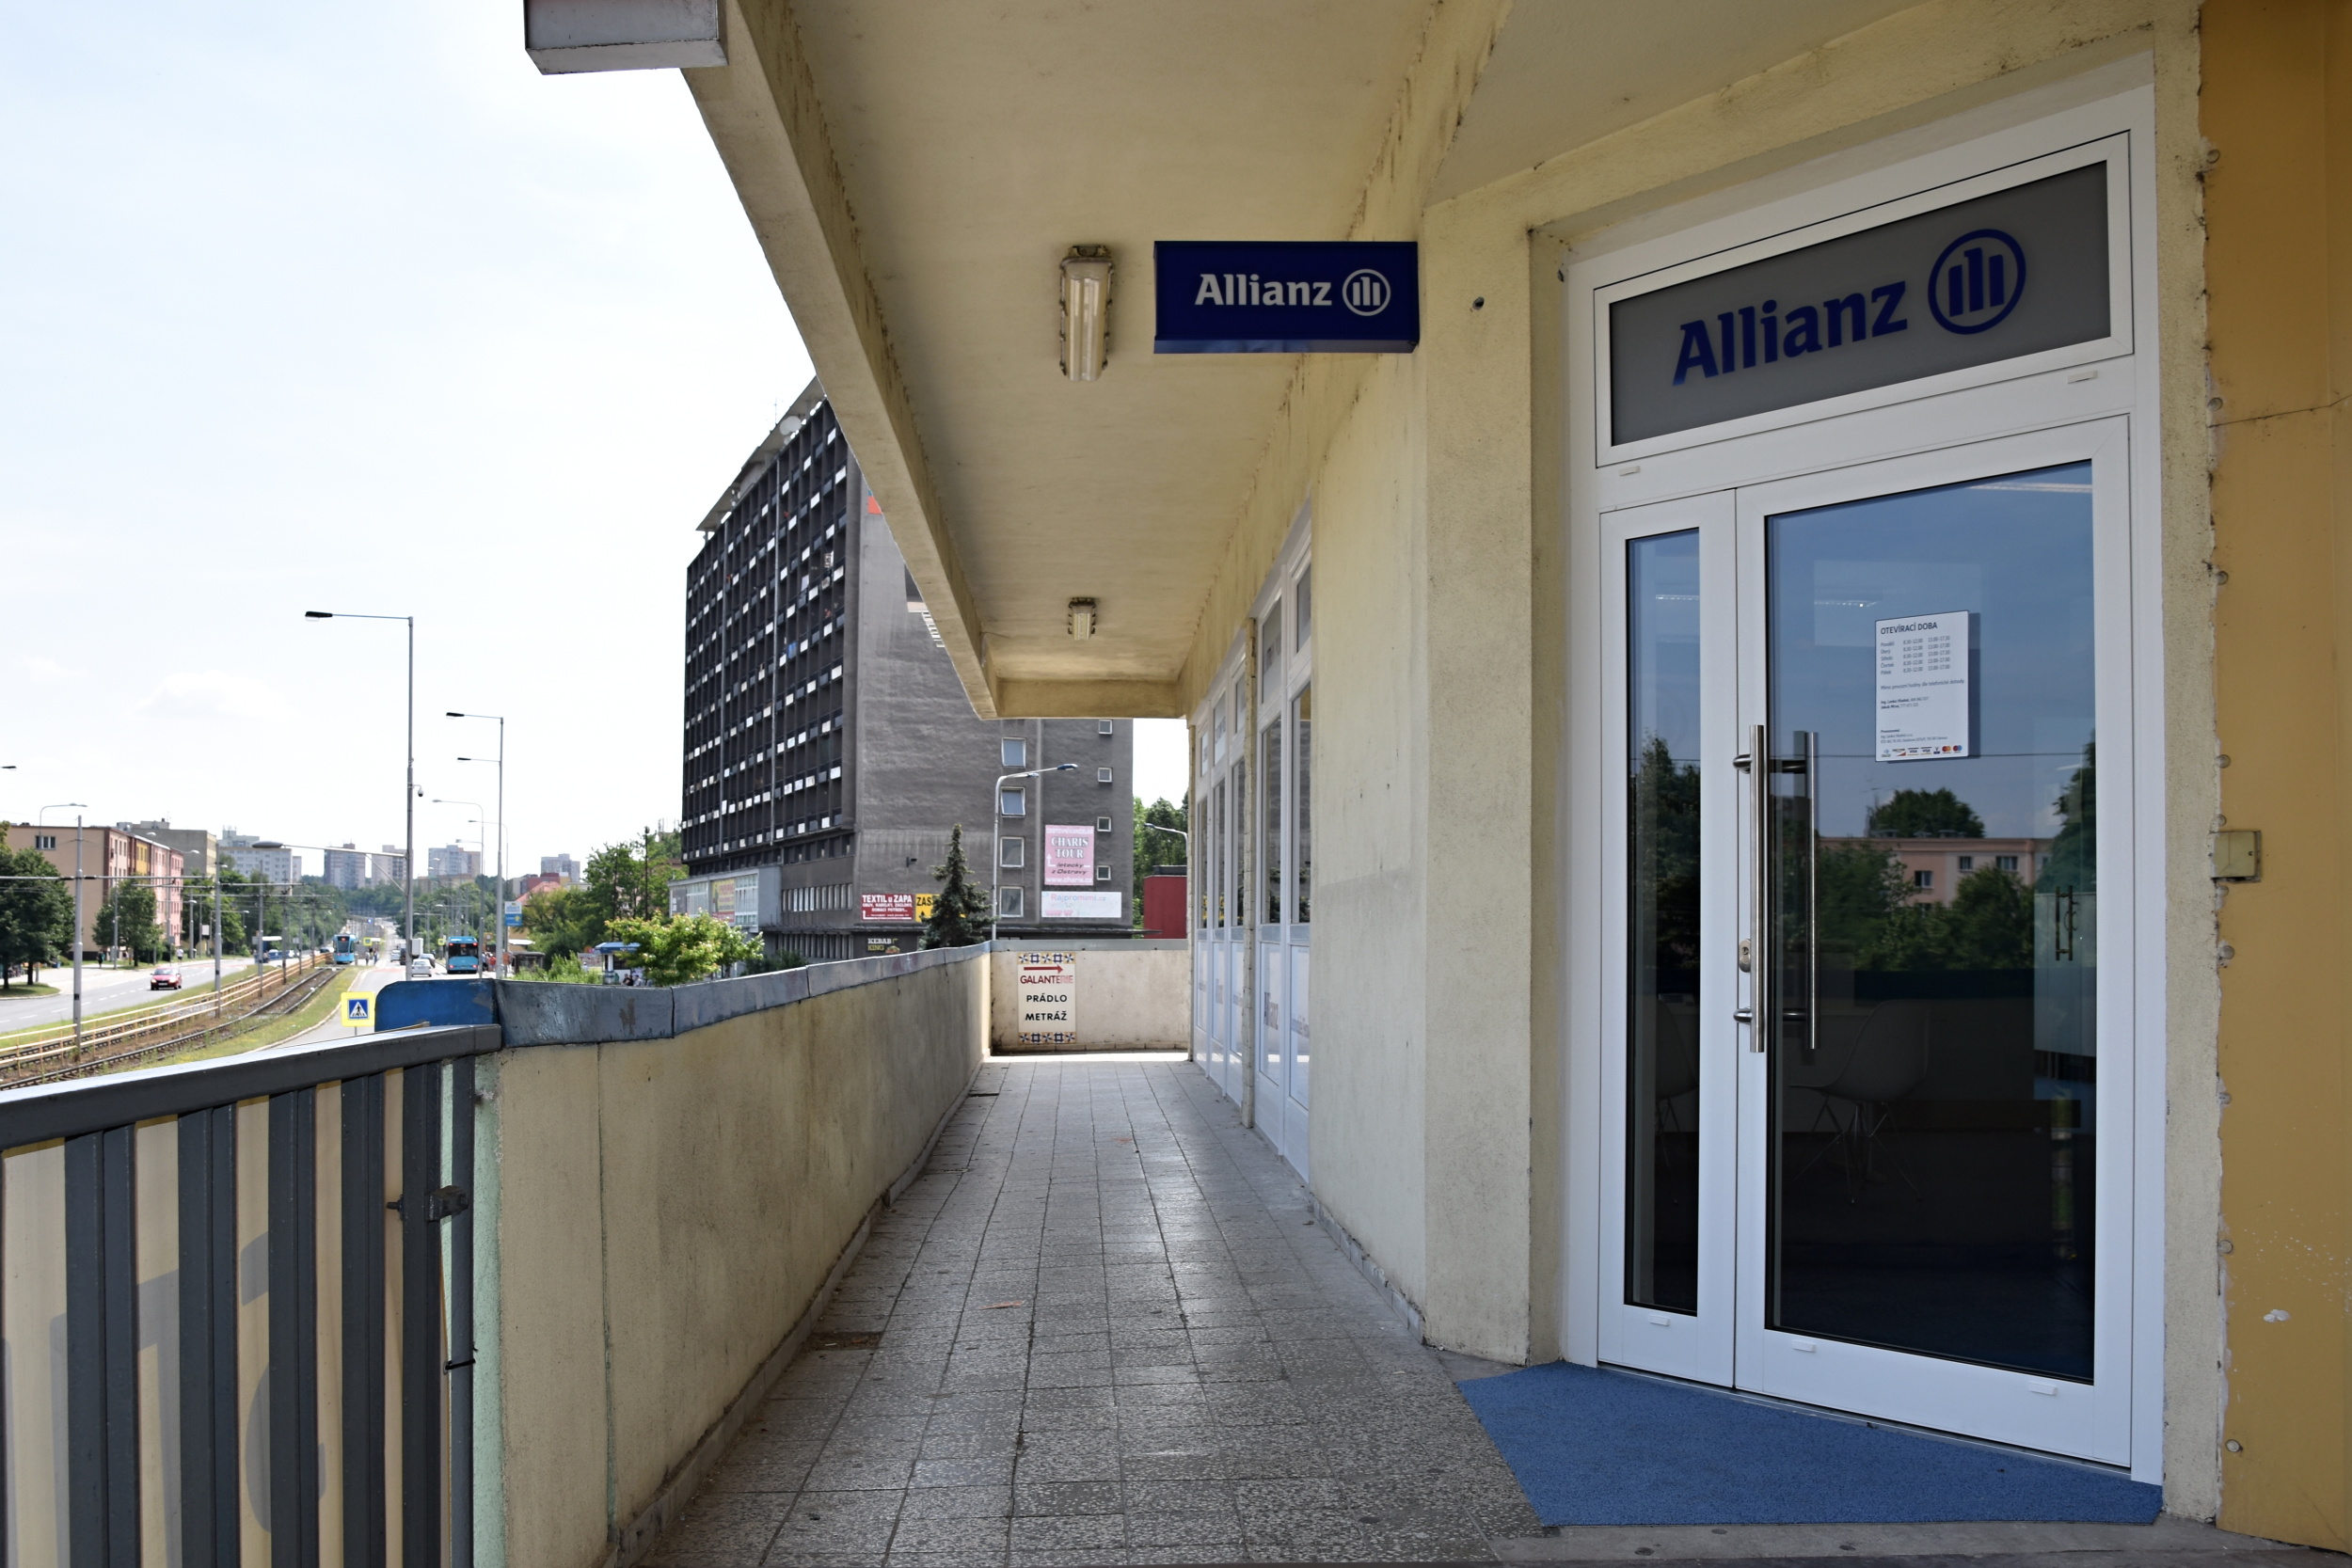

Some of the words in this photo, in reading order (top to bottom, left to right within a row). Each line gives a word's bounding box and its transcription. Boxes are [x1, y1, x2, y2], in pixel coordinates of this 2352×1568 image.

[1194, 272, 1333, 308] Allianz
[1672, 277, 1907, 387] Allianz
[1880, 623, 1916, 634] OTEVÍRACÍ
[1917, 622, 1938, 631] DOBA
[1051, 837, 1089, 847] CHARIS
[1056, 849, 1084, 858] TOUR
[862, 895, 887, 903] TEXTIL
[1020, 975, 1073, 984] GALANTERIE
[1026, 993, 1067, 1002] PRÁDLO
[1025, 1011, 1067, 1020] METRÁŽ
